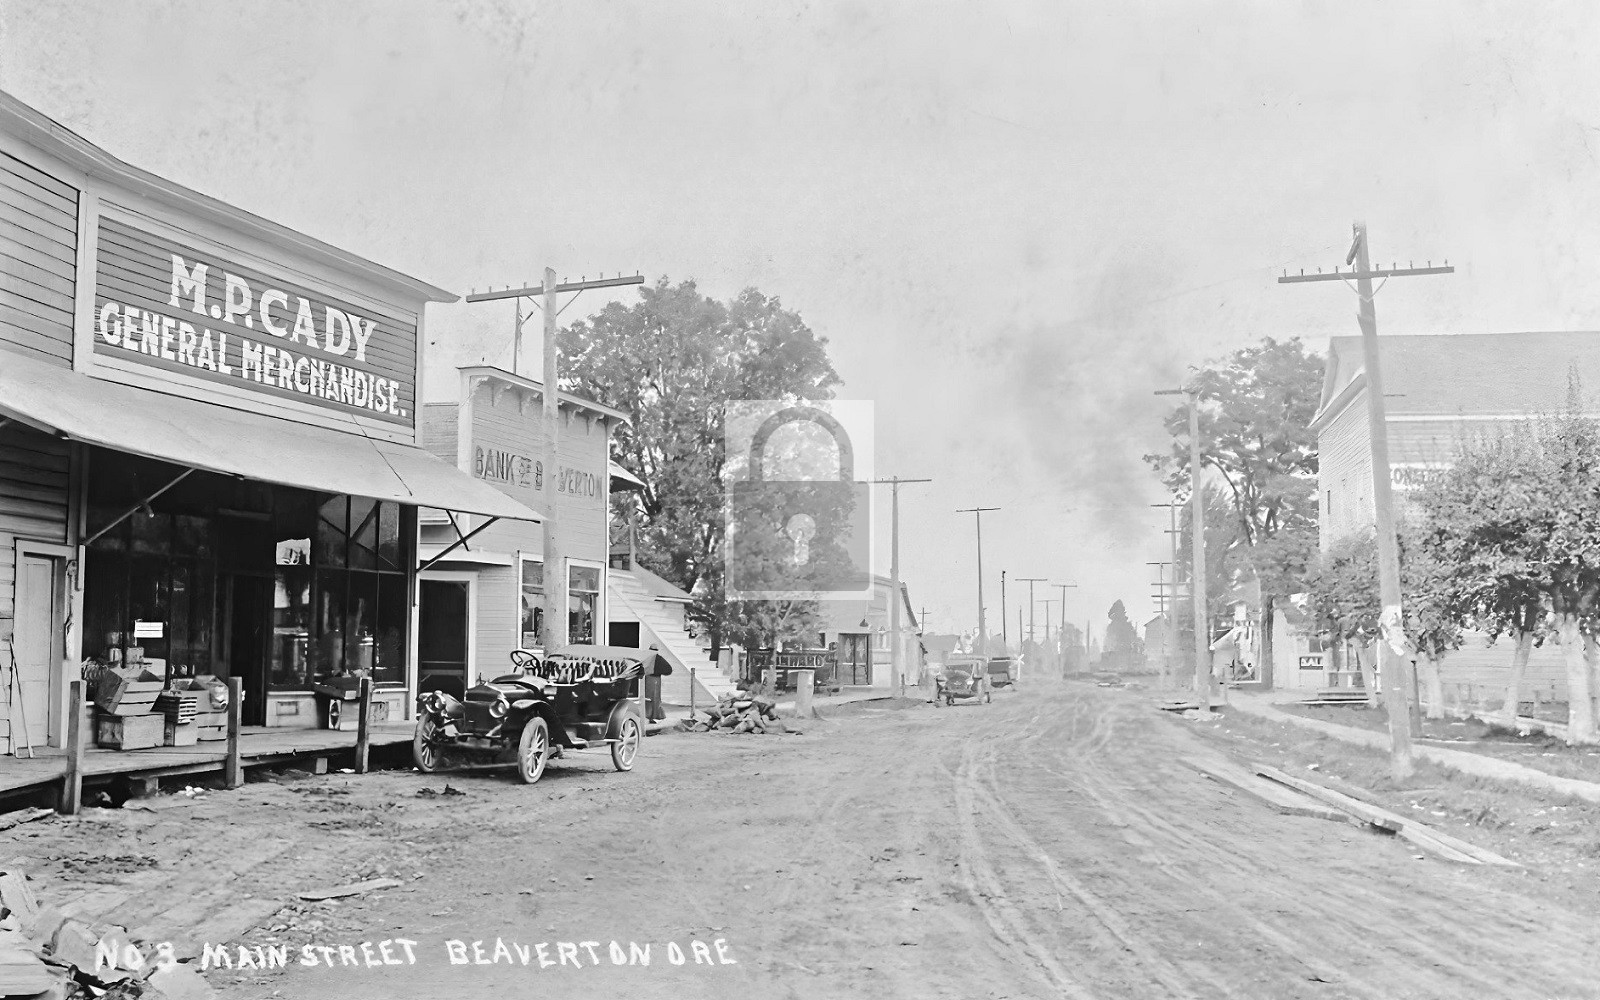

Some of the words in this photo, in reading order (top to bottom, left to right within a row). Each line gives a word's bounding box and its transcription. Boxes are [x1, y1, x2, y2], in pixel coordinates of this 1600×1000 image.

[97, 302, 231, 374] GENERAL
[241, 340, 407, 416] MERCHANDISE.
[475, 445, 516, 485] BANK
